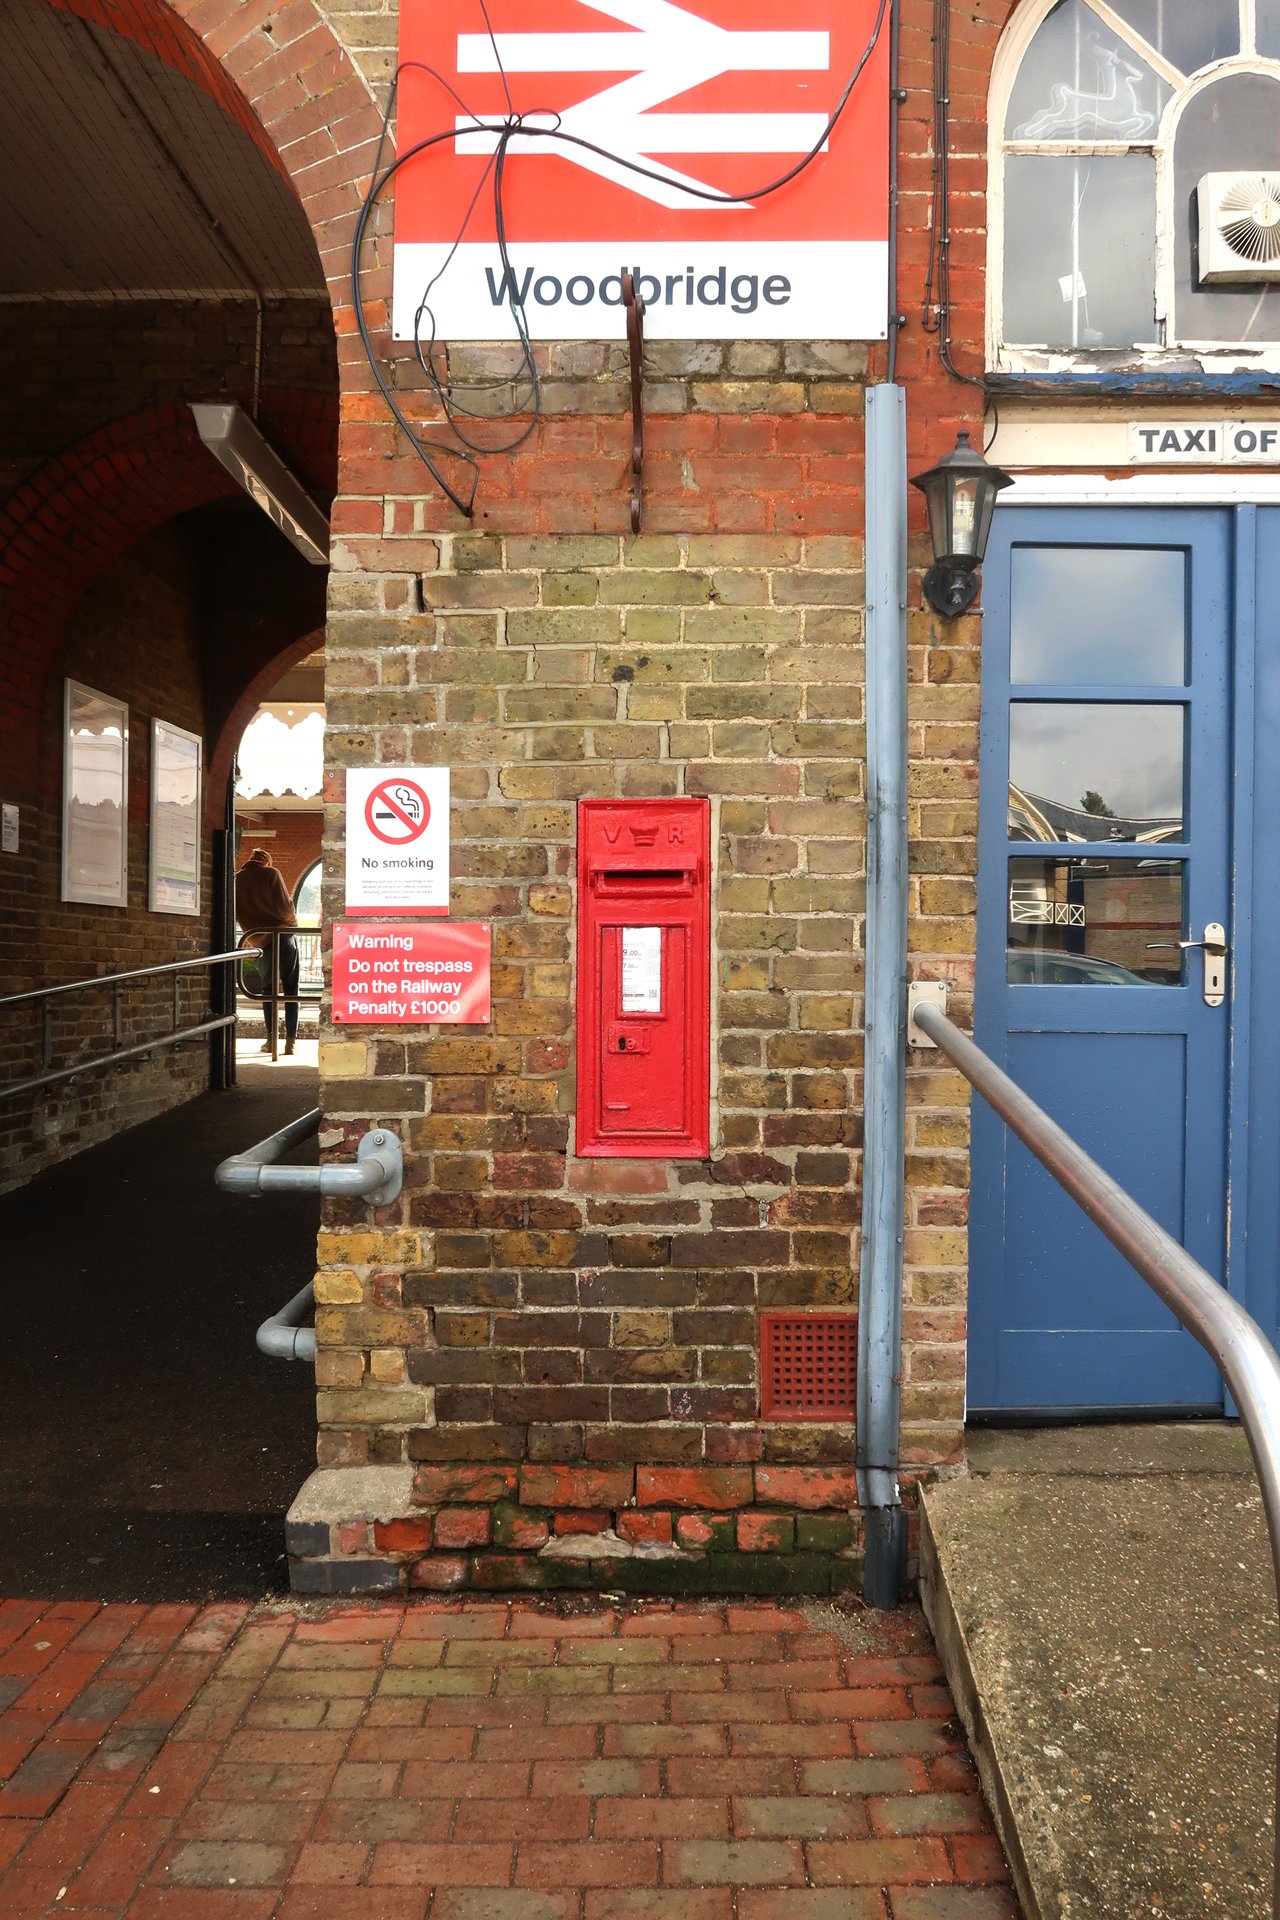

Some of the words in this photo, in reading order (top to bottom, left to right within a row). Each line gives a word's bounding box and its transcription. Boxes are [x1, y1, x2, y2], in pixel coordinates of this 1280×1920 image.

[485, 266, 792, 314] Woodbridge
[1139, 430, 1216, 452] TAXI
[1234, 430, 1277, 453] OF
[667, 826, 684, 844] R
[362, 858, 378, 868] No
[383, 857, 434, 870] smoking
[349, 935, 413, 951] Warning
[349, 959, 370, 972] Do
[374, 959, 399, 972] not
[403, 959, 473, 975] trespass
[349, 982, 368, 993] on
[371, 980, 397, 993] the
[401, 980, 461, 996] Railway
[349, 1001, 407, 1017] Penalty
[411, 1001, 460, 1014] £1000
